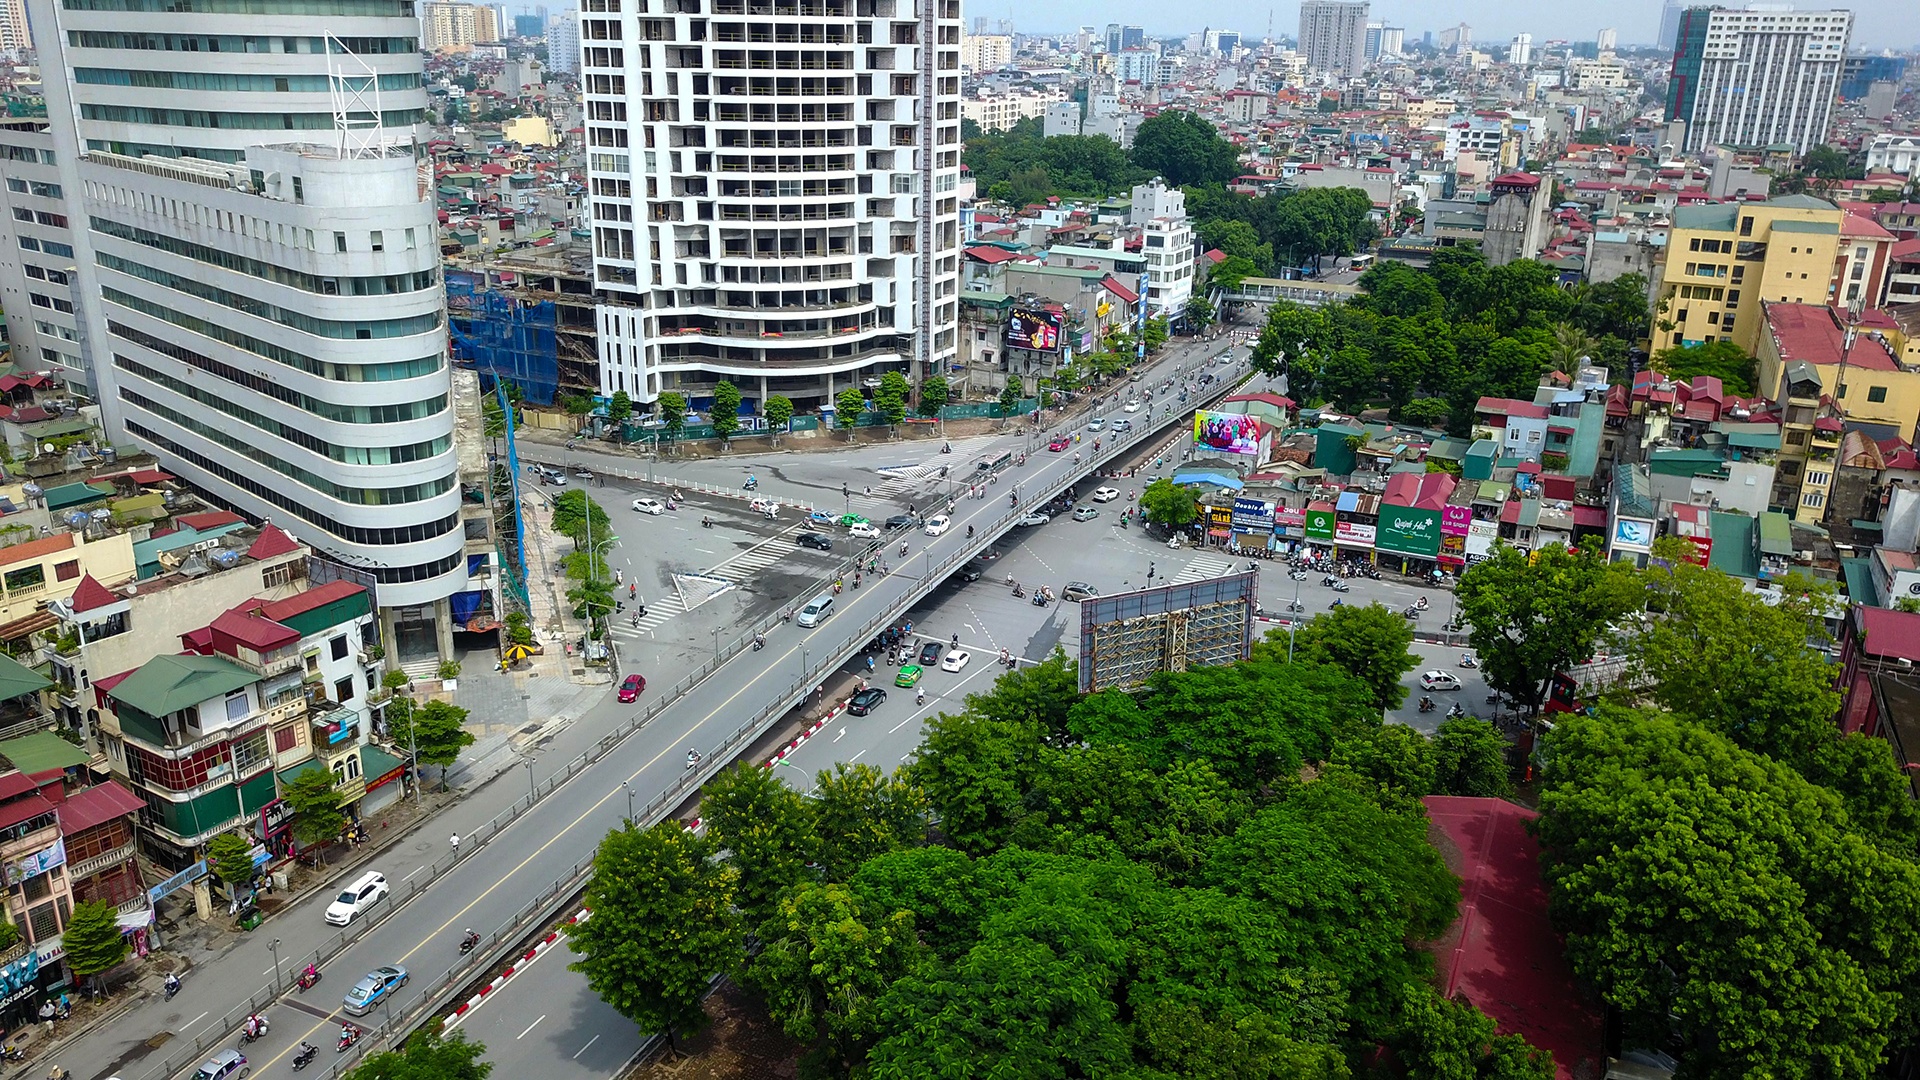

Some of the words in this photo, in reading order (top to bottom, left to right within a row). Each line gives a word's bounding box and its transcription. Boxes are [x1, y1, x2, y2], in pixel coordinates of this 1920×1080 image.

[1491, 185, 1533, 193] KARAOKE
[1235, 501, 1258, 511] Double
[13, 984, 35, 1001] ZARA
